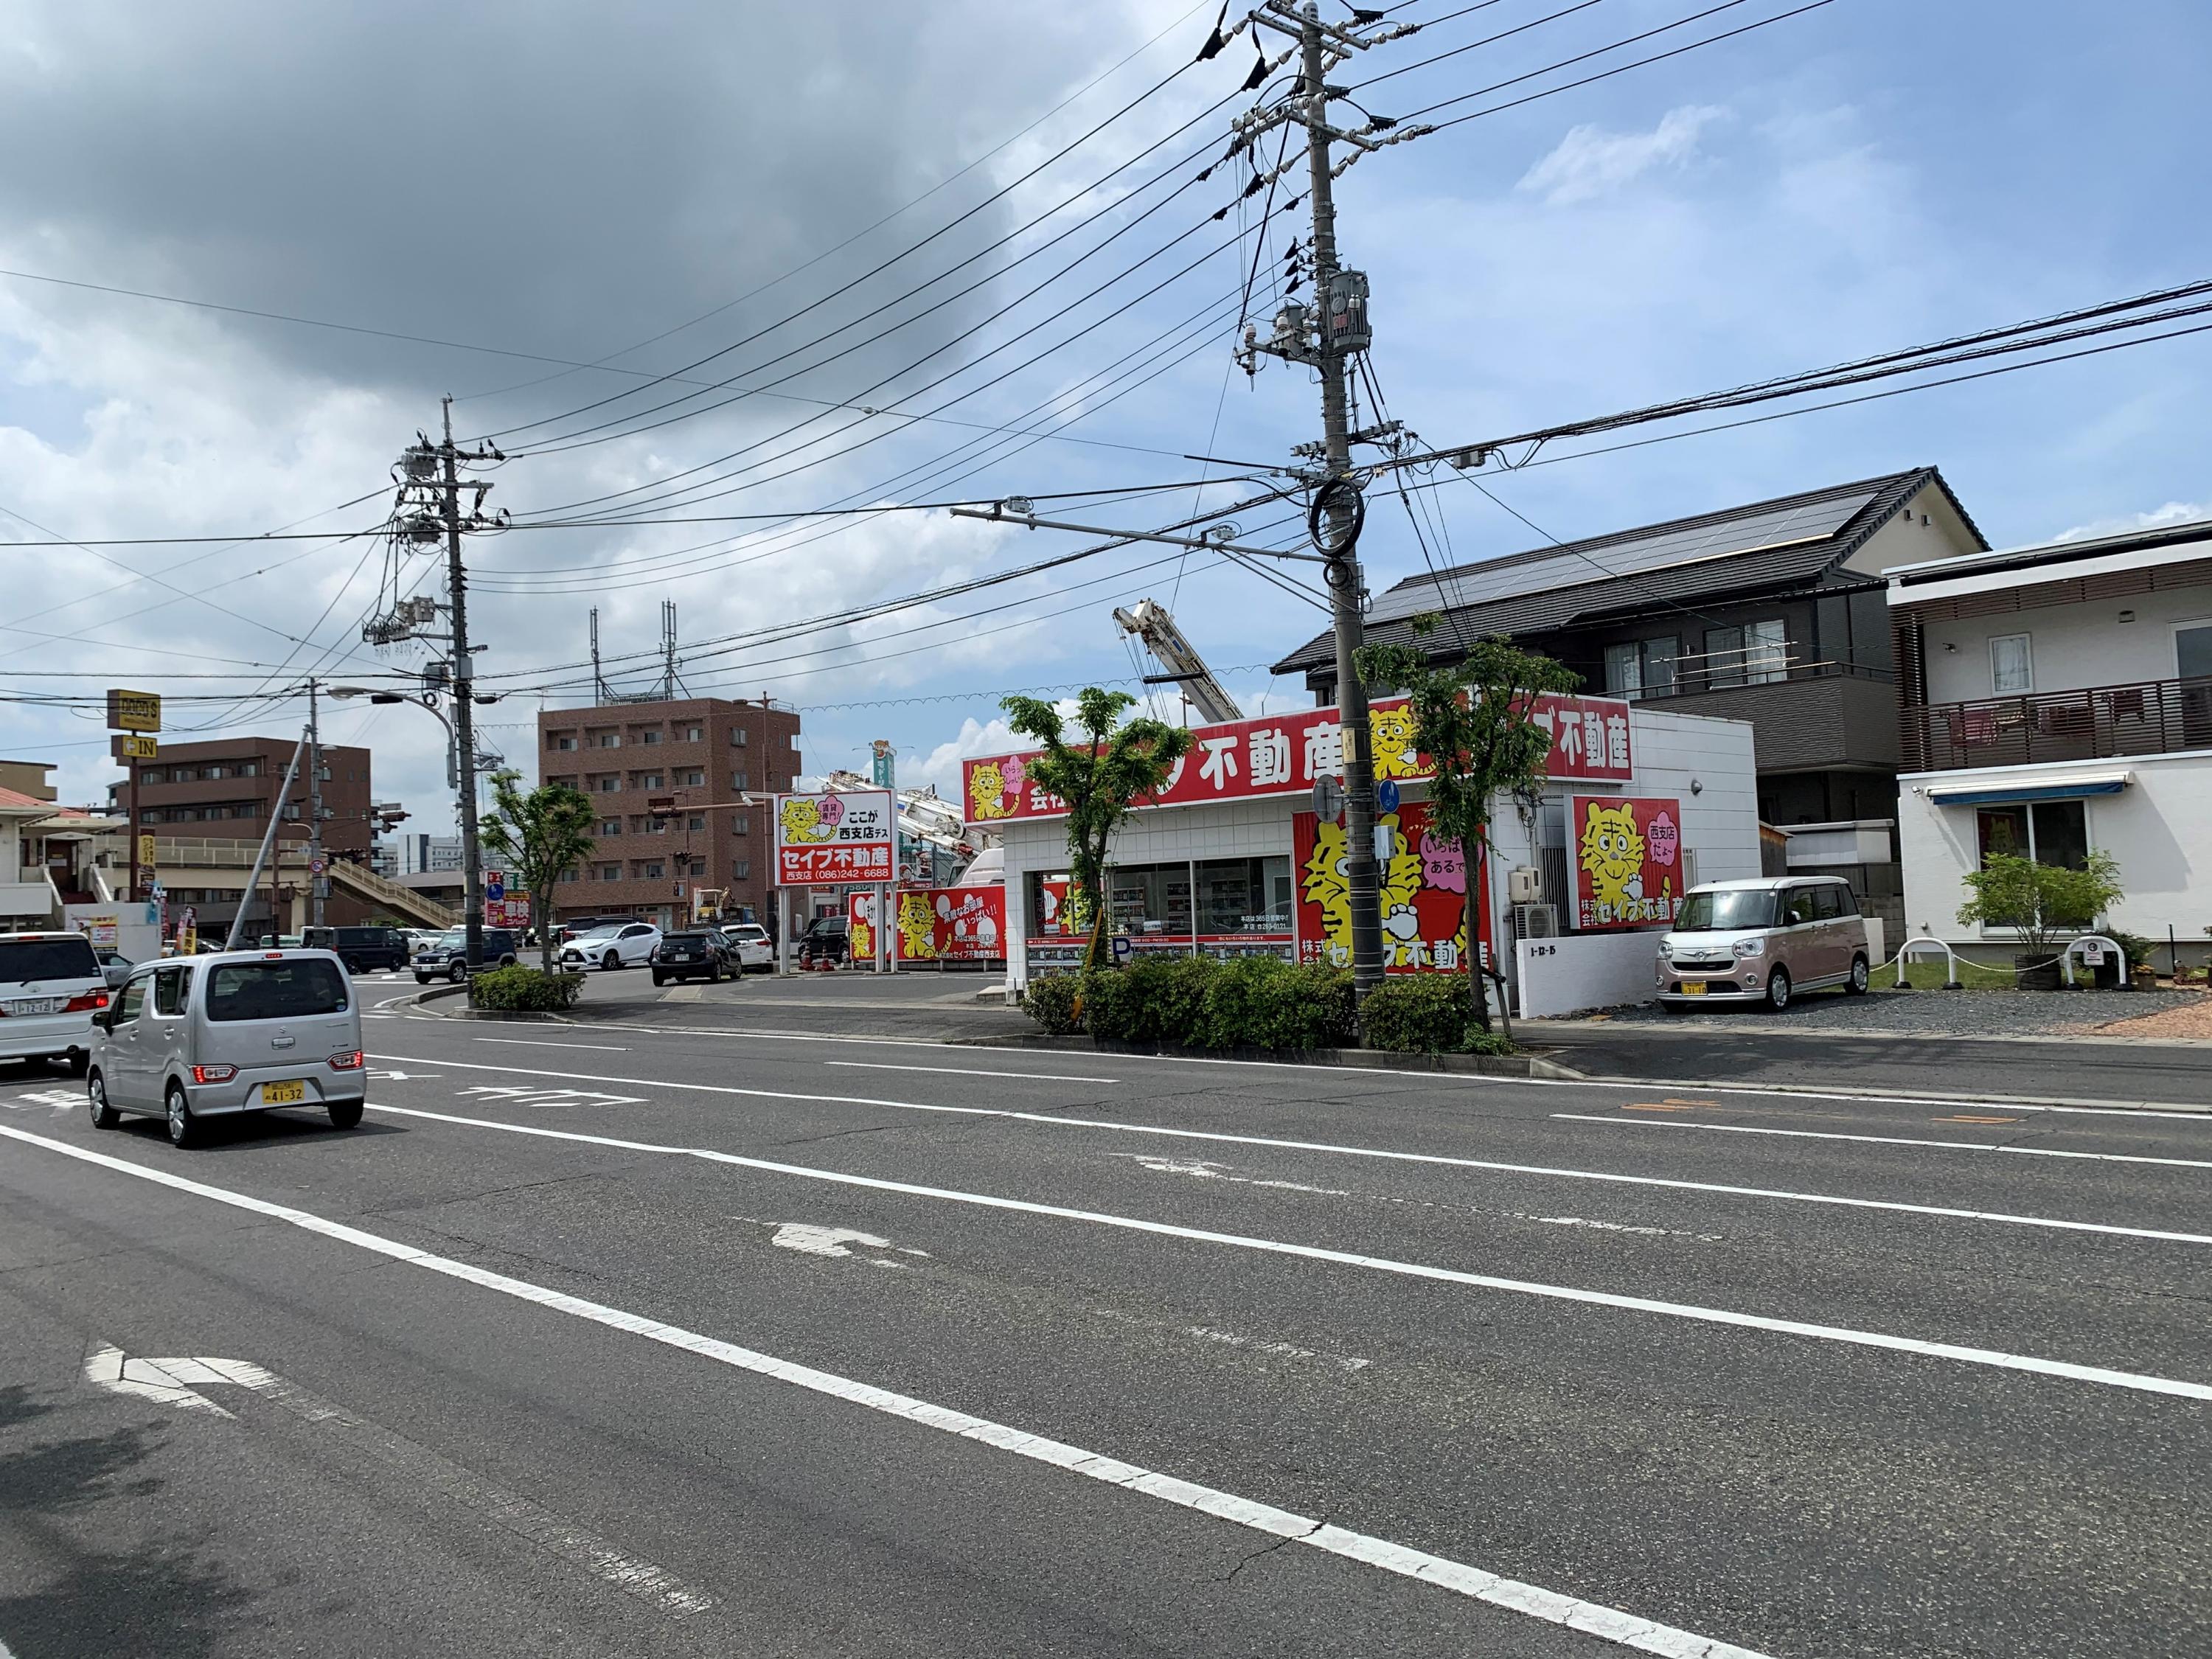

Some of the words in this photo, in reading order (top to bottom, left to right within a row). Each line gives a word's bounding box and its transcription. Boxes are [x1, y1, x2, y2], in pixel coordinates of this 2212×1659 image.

[138, 740, 154, 756] IN
[822, 804, 837, 812] 賃貸
[849, 810, 878, 824] ここが
[839, 827, 888, 840] 西支店デス
[1650, 825, 1674, 840] 西支店
[782, 846, 889, 869] セイブ不動産
[786, 871, 812, 880] 西支店
[815, 868, 888, 880] (086)242-6688
[504, 900, 529, 919] 車検
[943, 896, 984, 925] 素敵なお部屋
[1113, 938, 1130, 955] P
[1301, 939, 1326, 953] 株式
[27, 1004, 48, 1012] 12-12
[272, 1089, 302, 1101] 41-32
